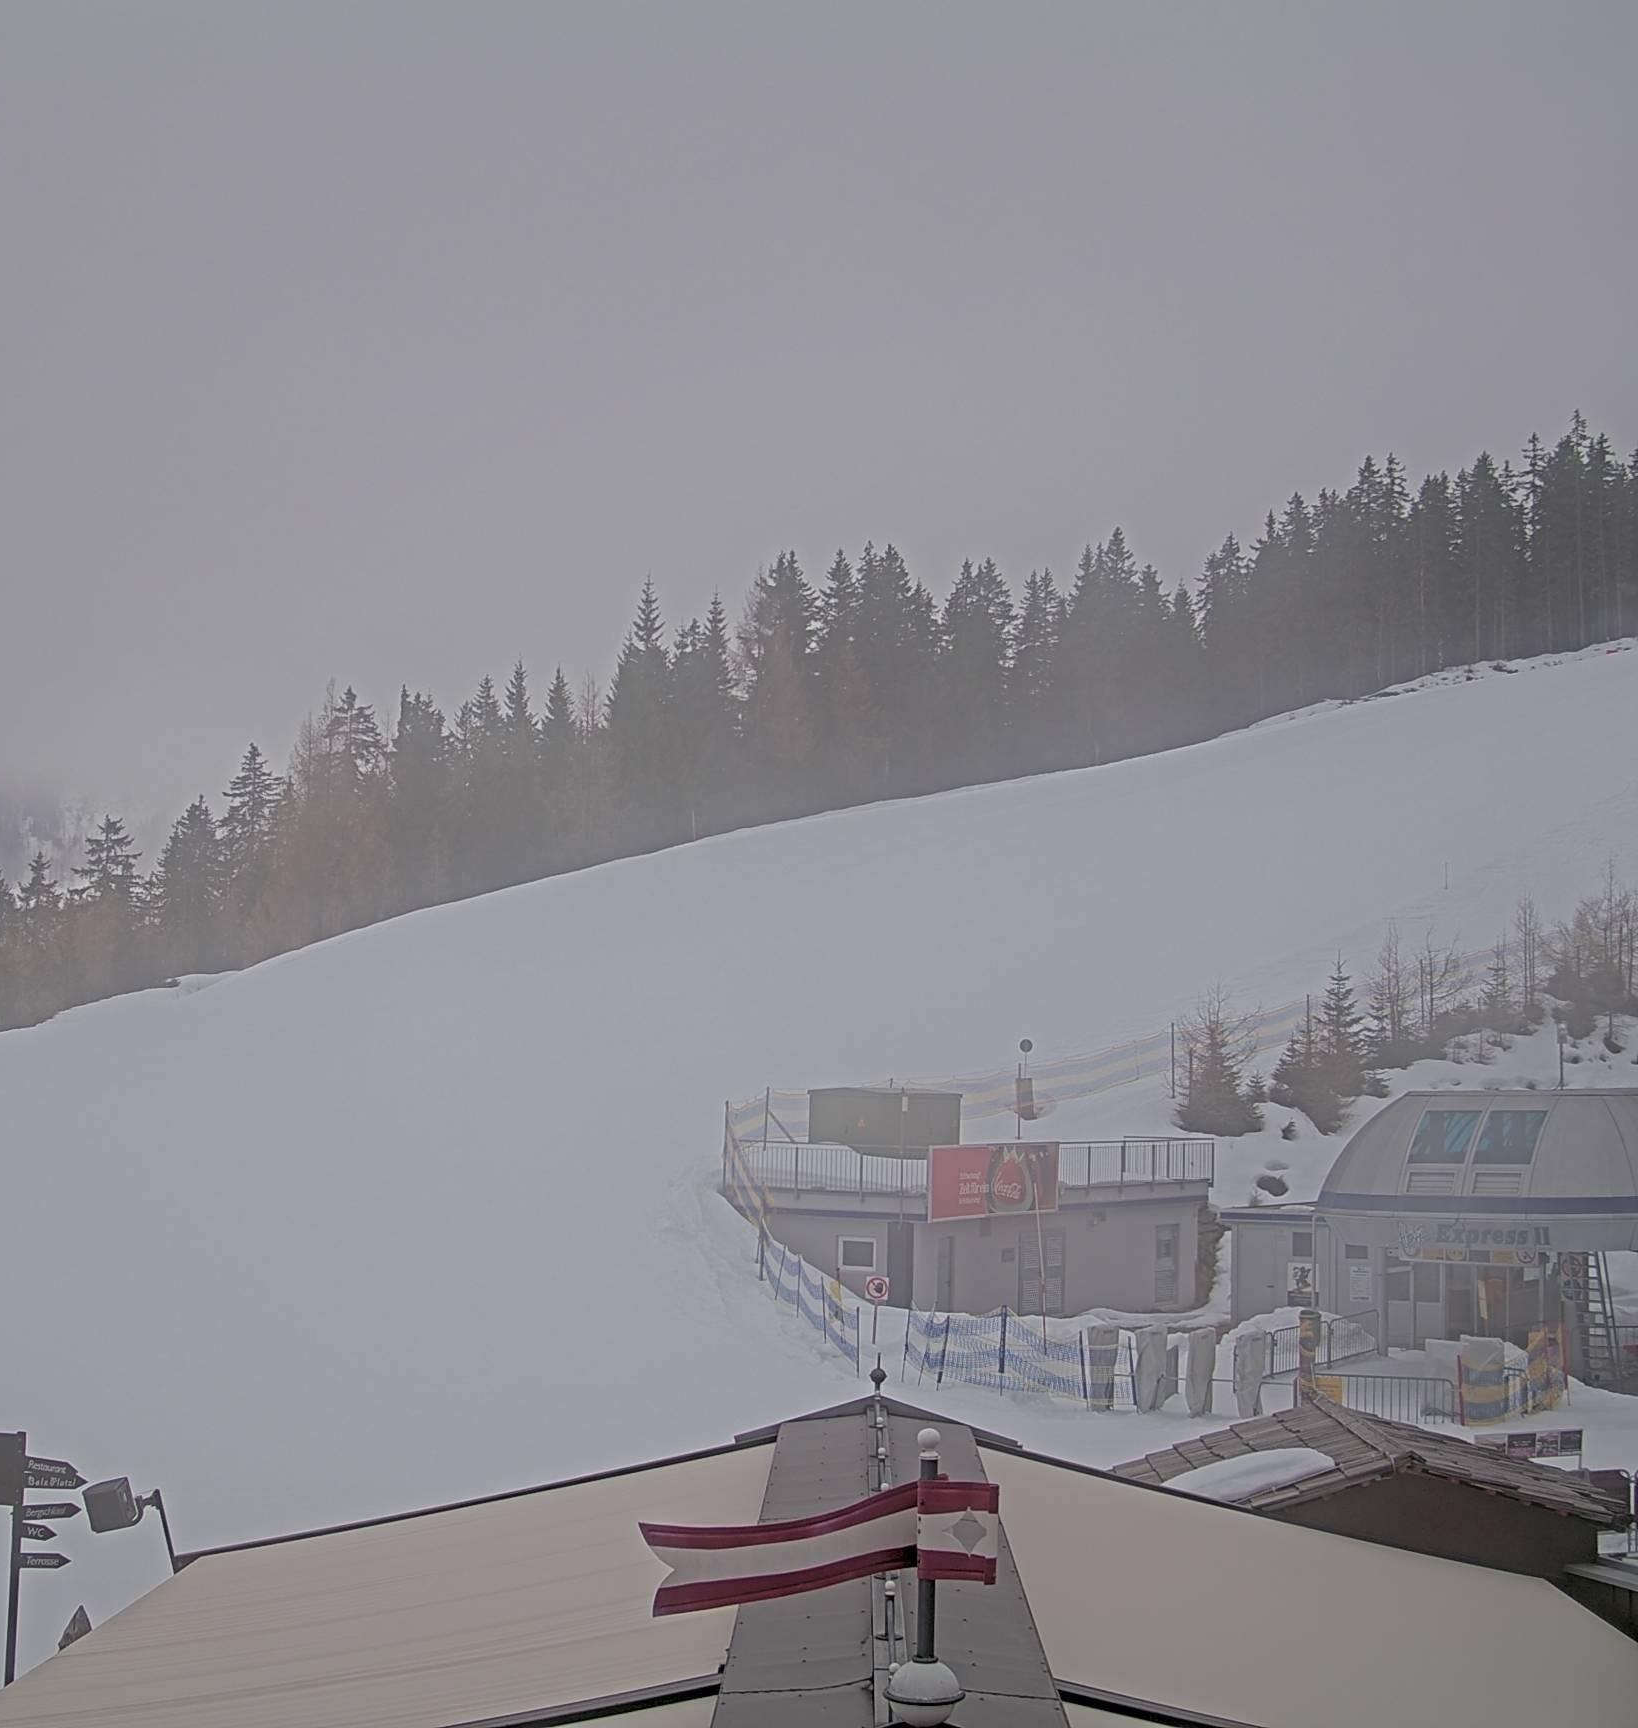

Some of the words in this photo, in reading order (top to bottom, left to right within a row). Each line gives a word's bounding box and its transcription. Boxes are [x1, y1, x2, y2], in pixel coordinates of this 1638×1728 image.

[1437, 1223, 1529, 1248] Express
[28, 1459, 67, 1474] Restaurant
[26, 1526, 45, 1537] WC
[26, 1556, 60, 1566] Terrasse
